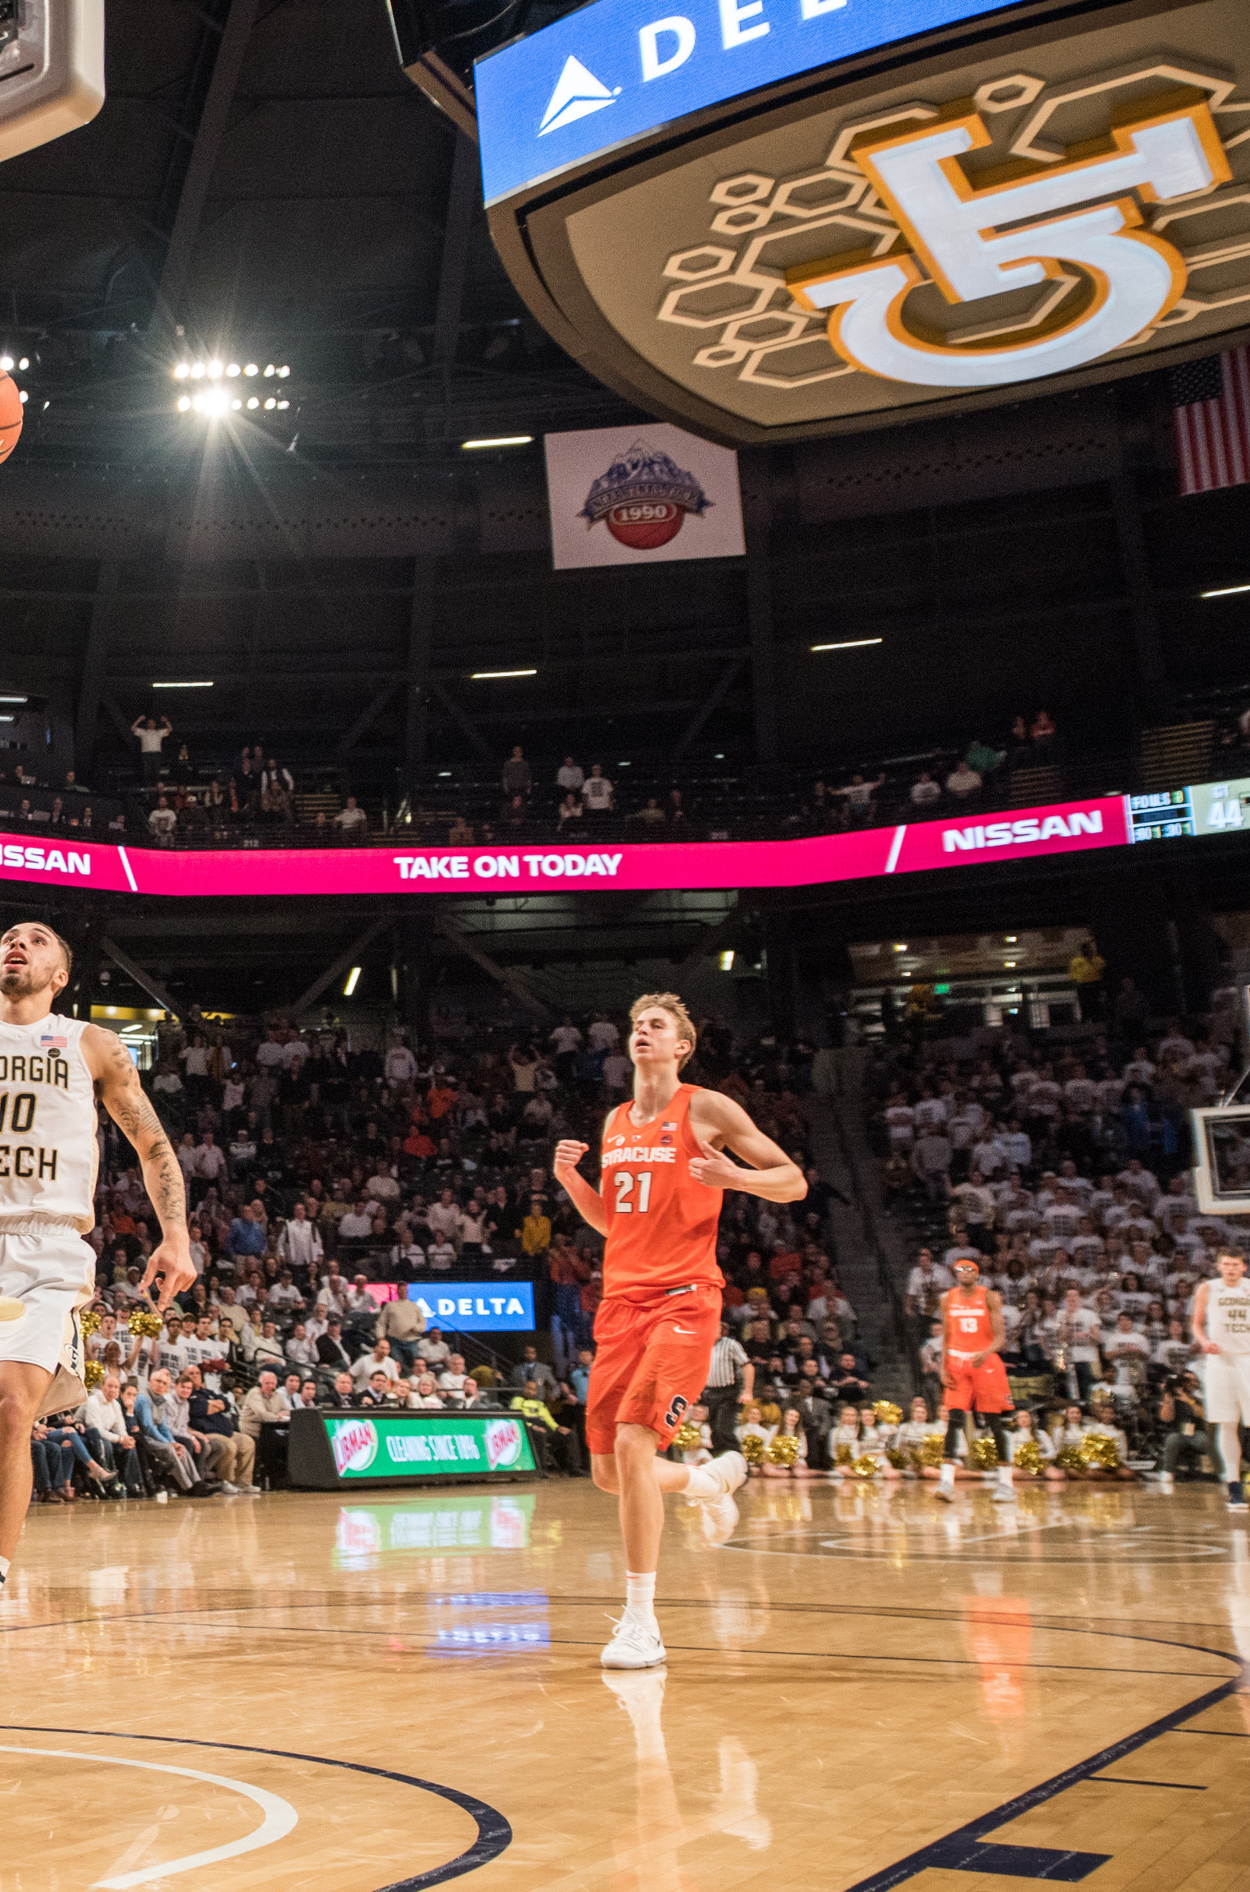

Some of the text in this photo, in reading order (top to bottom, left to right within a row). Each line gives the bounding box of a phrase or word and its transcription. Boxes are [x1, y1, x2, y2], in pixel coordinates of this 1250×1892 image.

[620, 504, 668, 522] 1990
[941, 809, 1104, 853] NISSAN
[393, 852, 624, 880] TAKE ON TODAY
[601, 1146, 677, 1168] SYRACUSE
[613, 1170, 653, 1214] 21
[438, 1297, 525, 1316] DELTA
[1228, 1309, 1246, 1321] 44
[663, 1393, 688, 1431] S
[386, 1435, 432, 1463] CLEANING
[428, 1435, 459, 1461] SINCE
